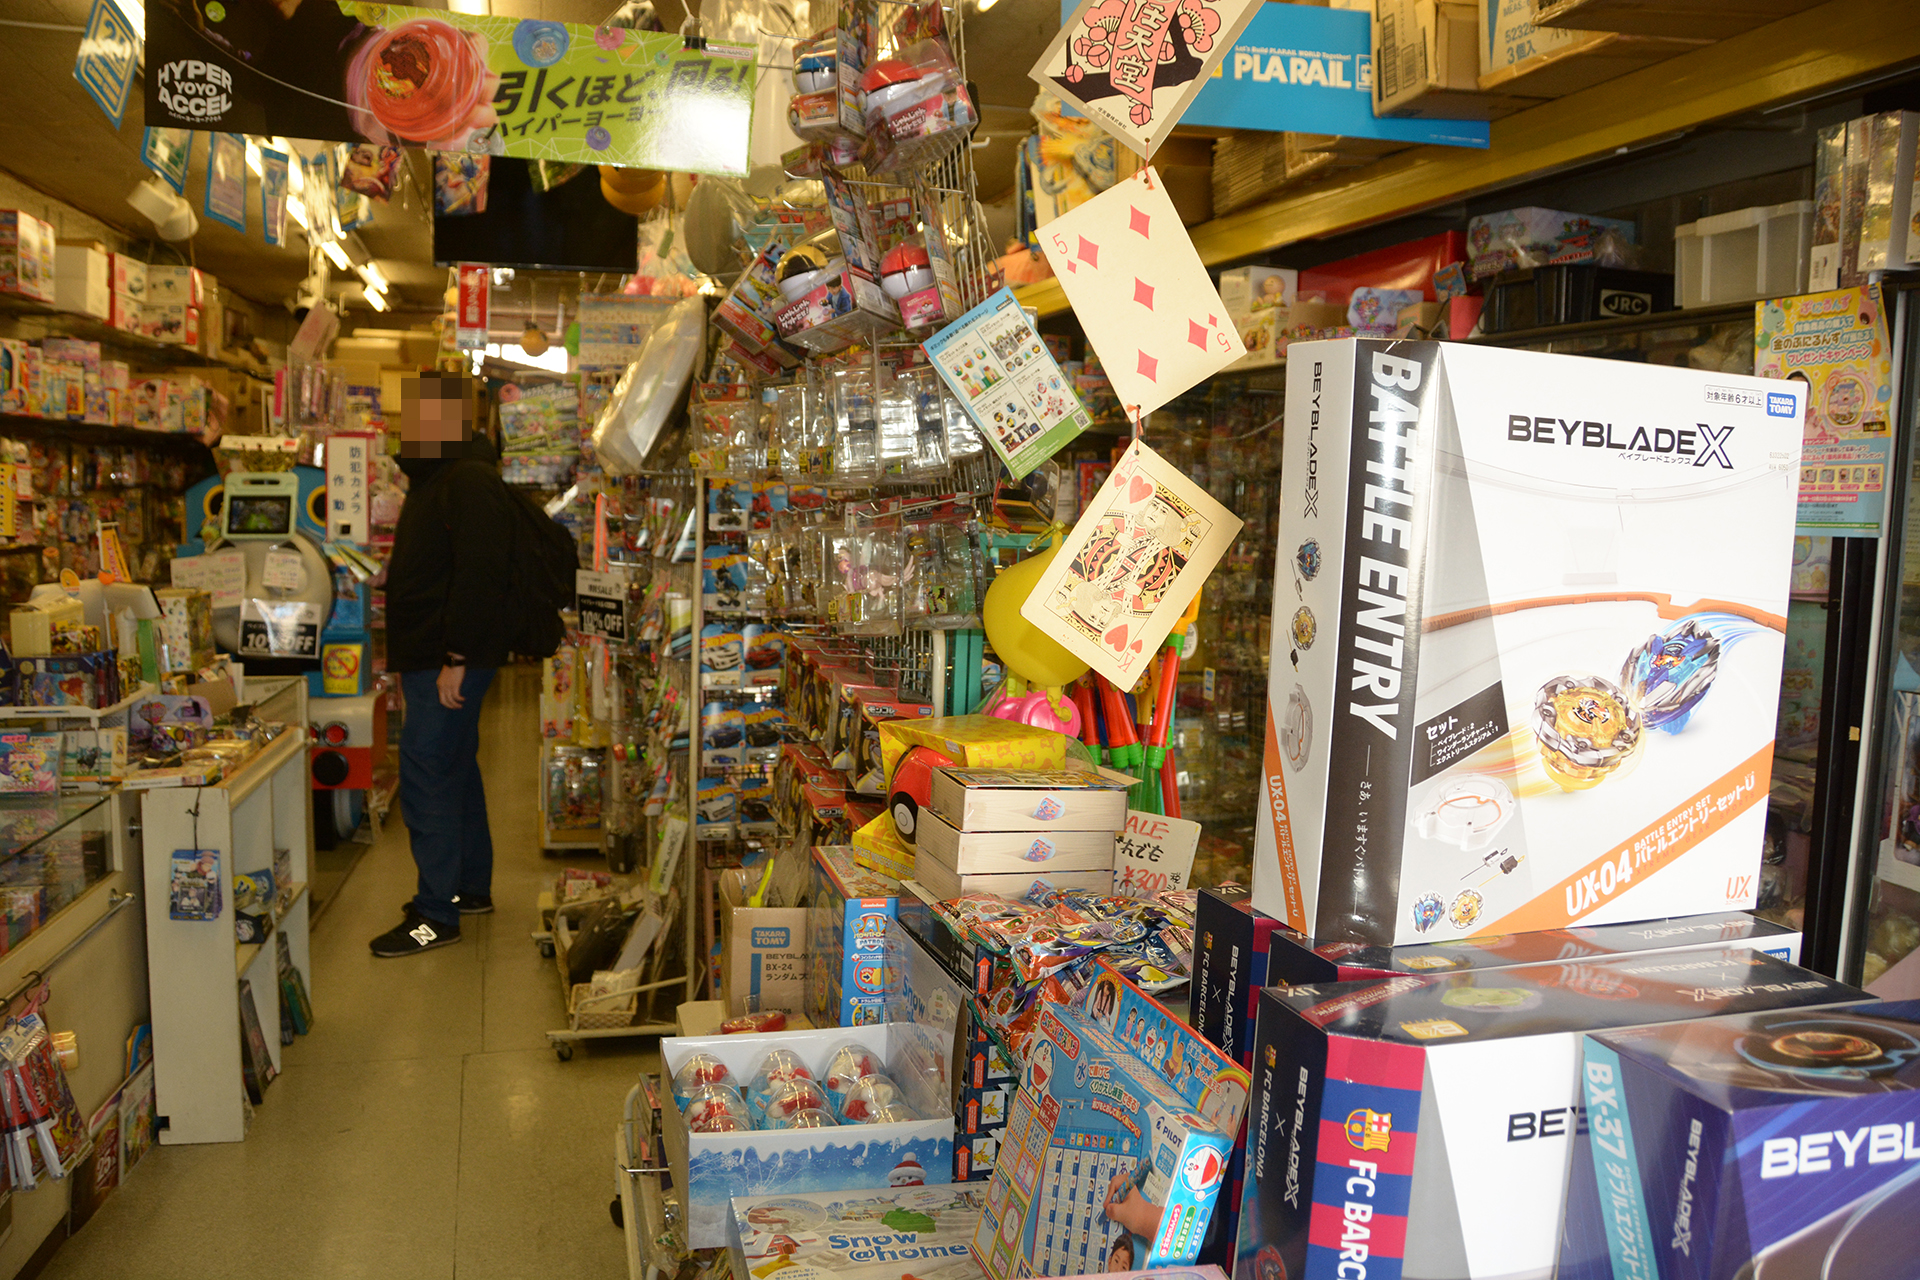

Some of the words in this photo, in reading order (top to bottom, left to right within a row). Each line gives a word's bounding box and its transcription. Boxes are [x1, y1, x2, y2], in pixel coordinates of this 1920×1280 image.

[1114, 0, 1168, 94] 任天堂
[1507, 40, 1537, 64] 3個入
[158, 60, 232, 95] HYPER
[1234, 53, 1352, 88] PLARAIL
[173, 81, 218, 97] YOYO
[158, 85, 233, 117] ACCEL
[1052, 233, 1069, 256] 5
[1608, 296, 1643, 313] JRC
[1216, 332, 1231, 353] 5
[1788, 346, 1870, 364] プレゼントキャンペーン
[1706, 391, 1762, 407] 対象年齢6才以上
[1769, 396, 1794, 406] TAKARA
[1769, 403, 1794, 415] TOMY
[1362, 351, 1422, 551] BATTLE
[1618, 452, 1692, 466] ベイブレードエックス
[1121, 454, 1140, 475] K
[1349, 554, 1410, 741] ENTRY
[1117, 654, 1135, 673] K
[867, 705, 897, 717] モンコレ
[1426, 715, 1458, 740] セット
[1269, 775, 1287, 823] UX-04
[817, 807, 844, 818] モンコレ
[1634, 825, 1666, 852] BATTLE
[1666, 806, 1694, 832] ENTRY
[1695, 794, 1711, 811] SET
[1123, 815, 1169, 840] ALE
[1636, 845, 1676, 877] XTREME
[1685, 822, 1711, 844] GEAR
[1565, 849, 1634, 917] UX-04
[1726, 875, 1753, 900] UX
[755, 930, 787, 938] TAKARA
[755, 937, 787, 946] TOMY
[765, 963, 793, 971] BX-24
[1202, 951, 1211, 968] FC
[1197, 968, 1210, 1037] BARCELON
[1263, 1069, 1273, 1090] FC
[1586, 1061, 1628, 1160] BX-37
[1162, 1125, 1183, 1149] PILOT
[1255, 1091, 1271, 1178] BARCELONA
[1345, 1158, 1378, 1198] FC
[827, 1233, 917, 1250] Snow
[848, 1243, 970, 1263] @home
